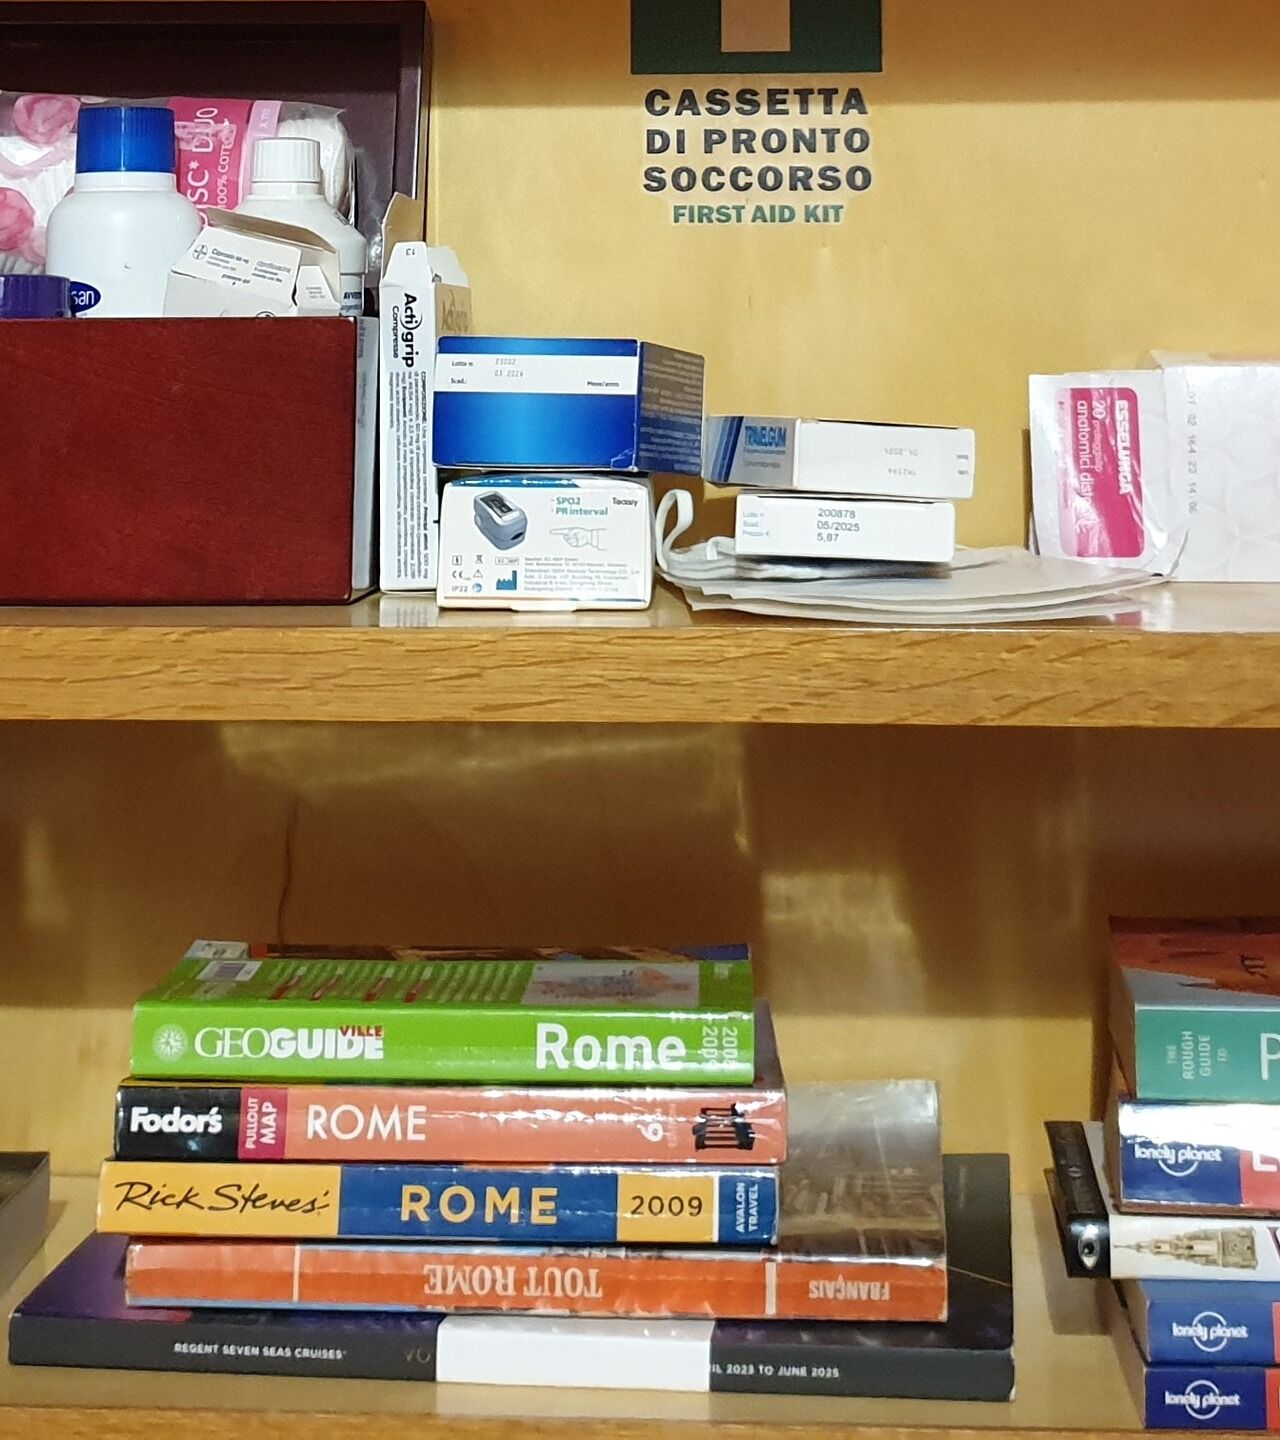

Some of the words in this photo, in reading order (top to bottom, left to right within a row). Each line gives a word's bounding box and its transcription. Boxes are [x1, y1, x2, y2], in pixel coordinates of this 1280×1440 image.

[644, 87, 868, 116] CASSETTA
[646, 128, 686, 154] DI
[703, 127, 870, 154] PRONTO
[643, 165, 872, 192] SOCCORSO
[673, 204, 745, 224] FIRST
[751, 204, 795, 224] AID
[804, 204, 844, 224] KIT
[392, 305, 400, 359] Compresse
[400, 292, 424, 368] Actigrip
[1092, 399, 1107, 421] 20
[1077, 400, 1093, 470] anatomici
[556, 496, 581, 506] SPO2
[570, 506, 609, 516] interval
[816, 520, 861, 533] 05/2025
[194, 1026, 385, 1060] GEOGUIDE
[339, 1024, 384, 1038] VILLE
[535, 1021, 688, 1071] Rome
[1181, 1030, 1195, 1081] ROUGH
[1198, 1033, 1212, 1077] GUIDE
[129, 1106, 222, 1135] Fodor's
[245, 1096, 259, 1149] PULLOUT
[259, 1101, 277, 1145] MAP
[306, 1103, 428, 1142] ROME
[1134, 1142, 1176, 1164] lonely
[1177, 1146, 1223, 1164] planet
[115, 1180, 204, 1212] Rick
[399, 1184, 558, 1225] ROME
[630, 1195, 703, 1218] 2009
[735, 1181, 747, 1234] AVALON
[748, 1183, 760, 1233] TRAVEL
[423, 1262, 516, 1297] ROME
[522, 1265, 604, 1300] TOUT
[808, 1272, 891, 1302] FRANÇAIS
[1172, 1322, 1208, 1341] lonely
[1208, 1323, 1249, 1340] planet
[173, 1341, 219, 1356] REGENT
[222, 1343, 260, 1357] SEVEN
[262, 1345, 292, 1359] SEAS
[295, 1346, 343, 1360] CRUISES
[726, 1363, 755, 1376] 2023
[759, 1364, 775, 1377] TO
[777, 1365, 807, 1378] JUNE
[1164, 1391, 1202, 1409] lonely
[1202, 1391, 1241, 1408] planet
